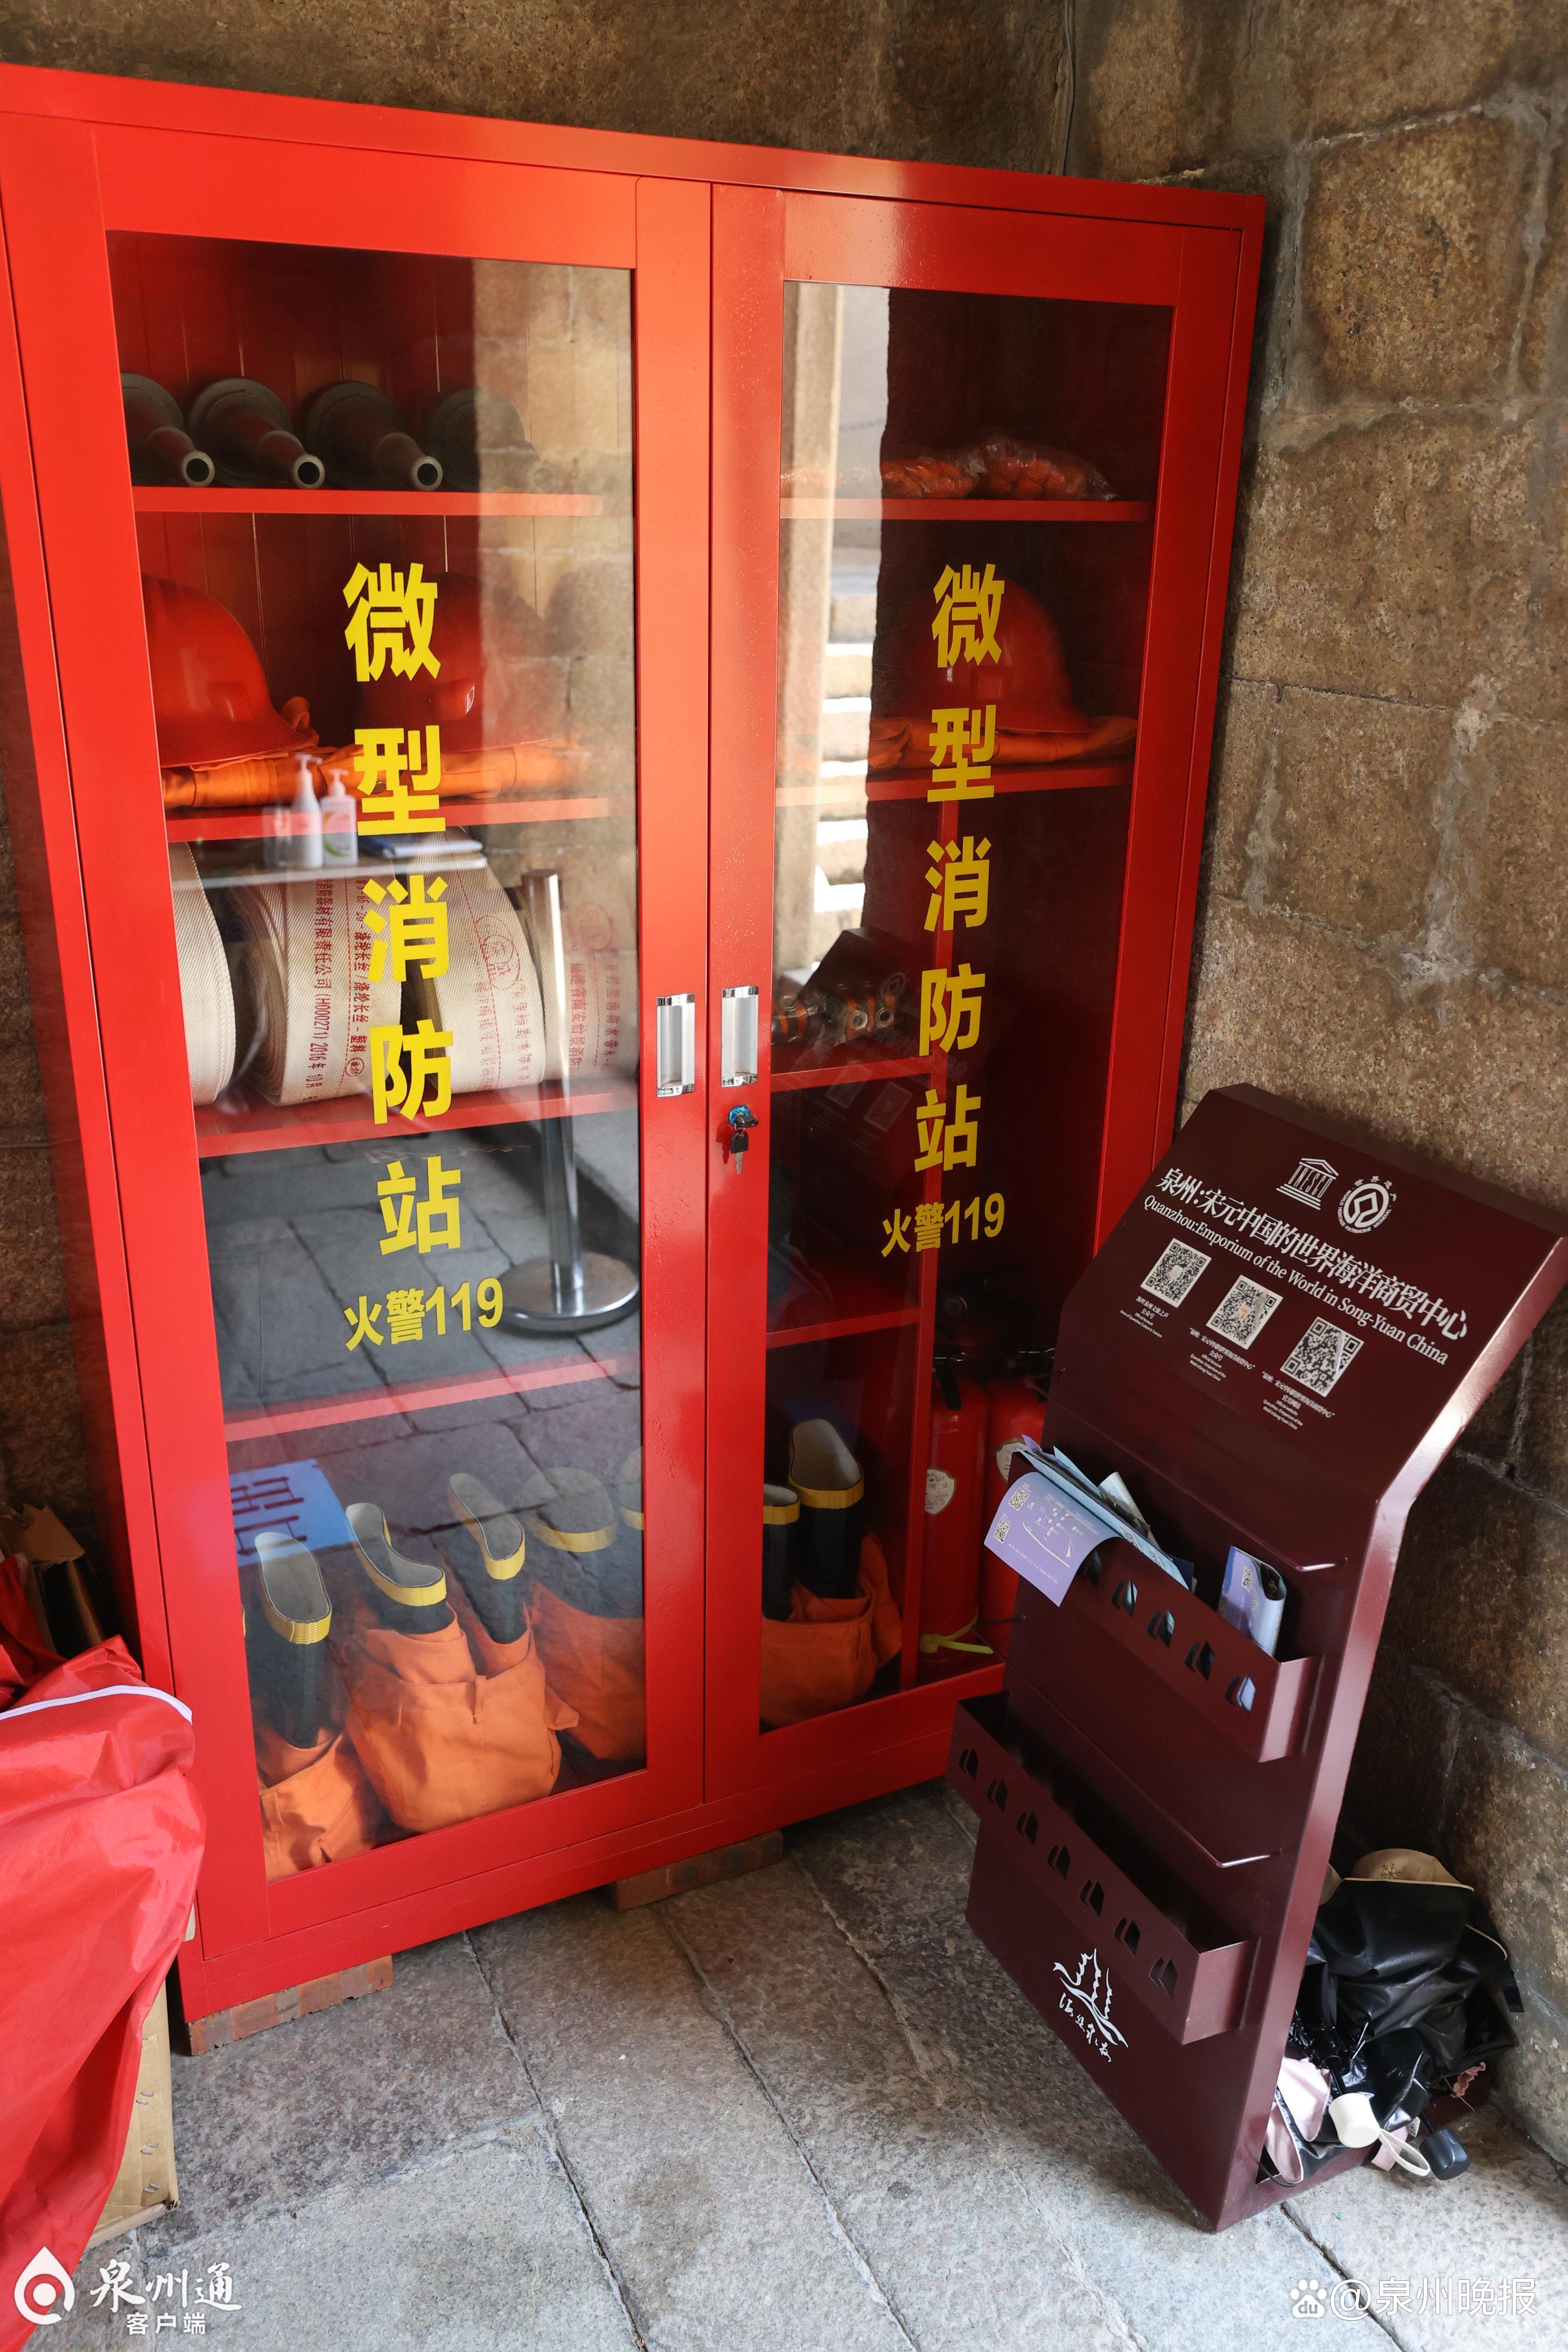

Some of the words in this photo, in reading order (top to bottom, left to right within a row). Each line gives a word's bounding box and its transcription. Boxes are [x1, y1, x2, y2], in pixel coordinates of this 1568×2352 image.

[914, 564, 1005, 1173] 微型消防站
[344, 563, 460, 1254] 微型消防站
[1288, 1165, 1333, 1199] UNESCO
[1339, 1189, 1352, 1207] WORLD
[1373, 1209, 1392, 1228] MONDIAL
[881, 1192, 1005, 1258] 火警119
[344, 1277, 503, 1350] 火警119
[1253, 1255, 1271, 1269] of
[1266, 1259, 1287, 1279] the
[1287, 1269, 1327, 1300] World
[1322, 1288, 1339, 1307] in
[1337, 1297, 1406, 1342] Song-Yuan
[1406, 1333, 1449, 1366] China
